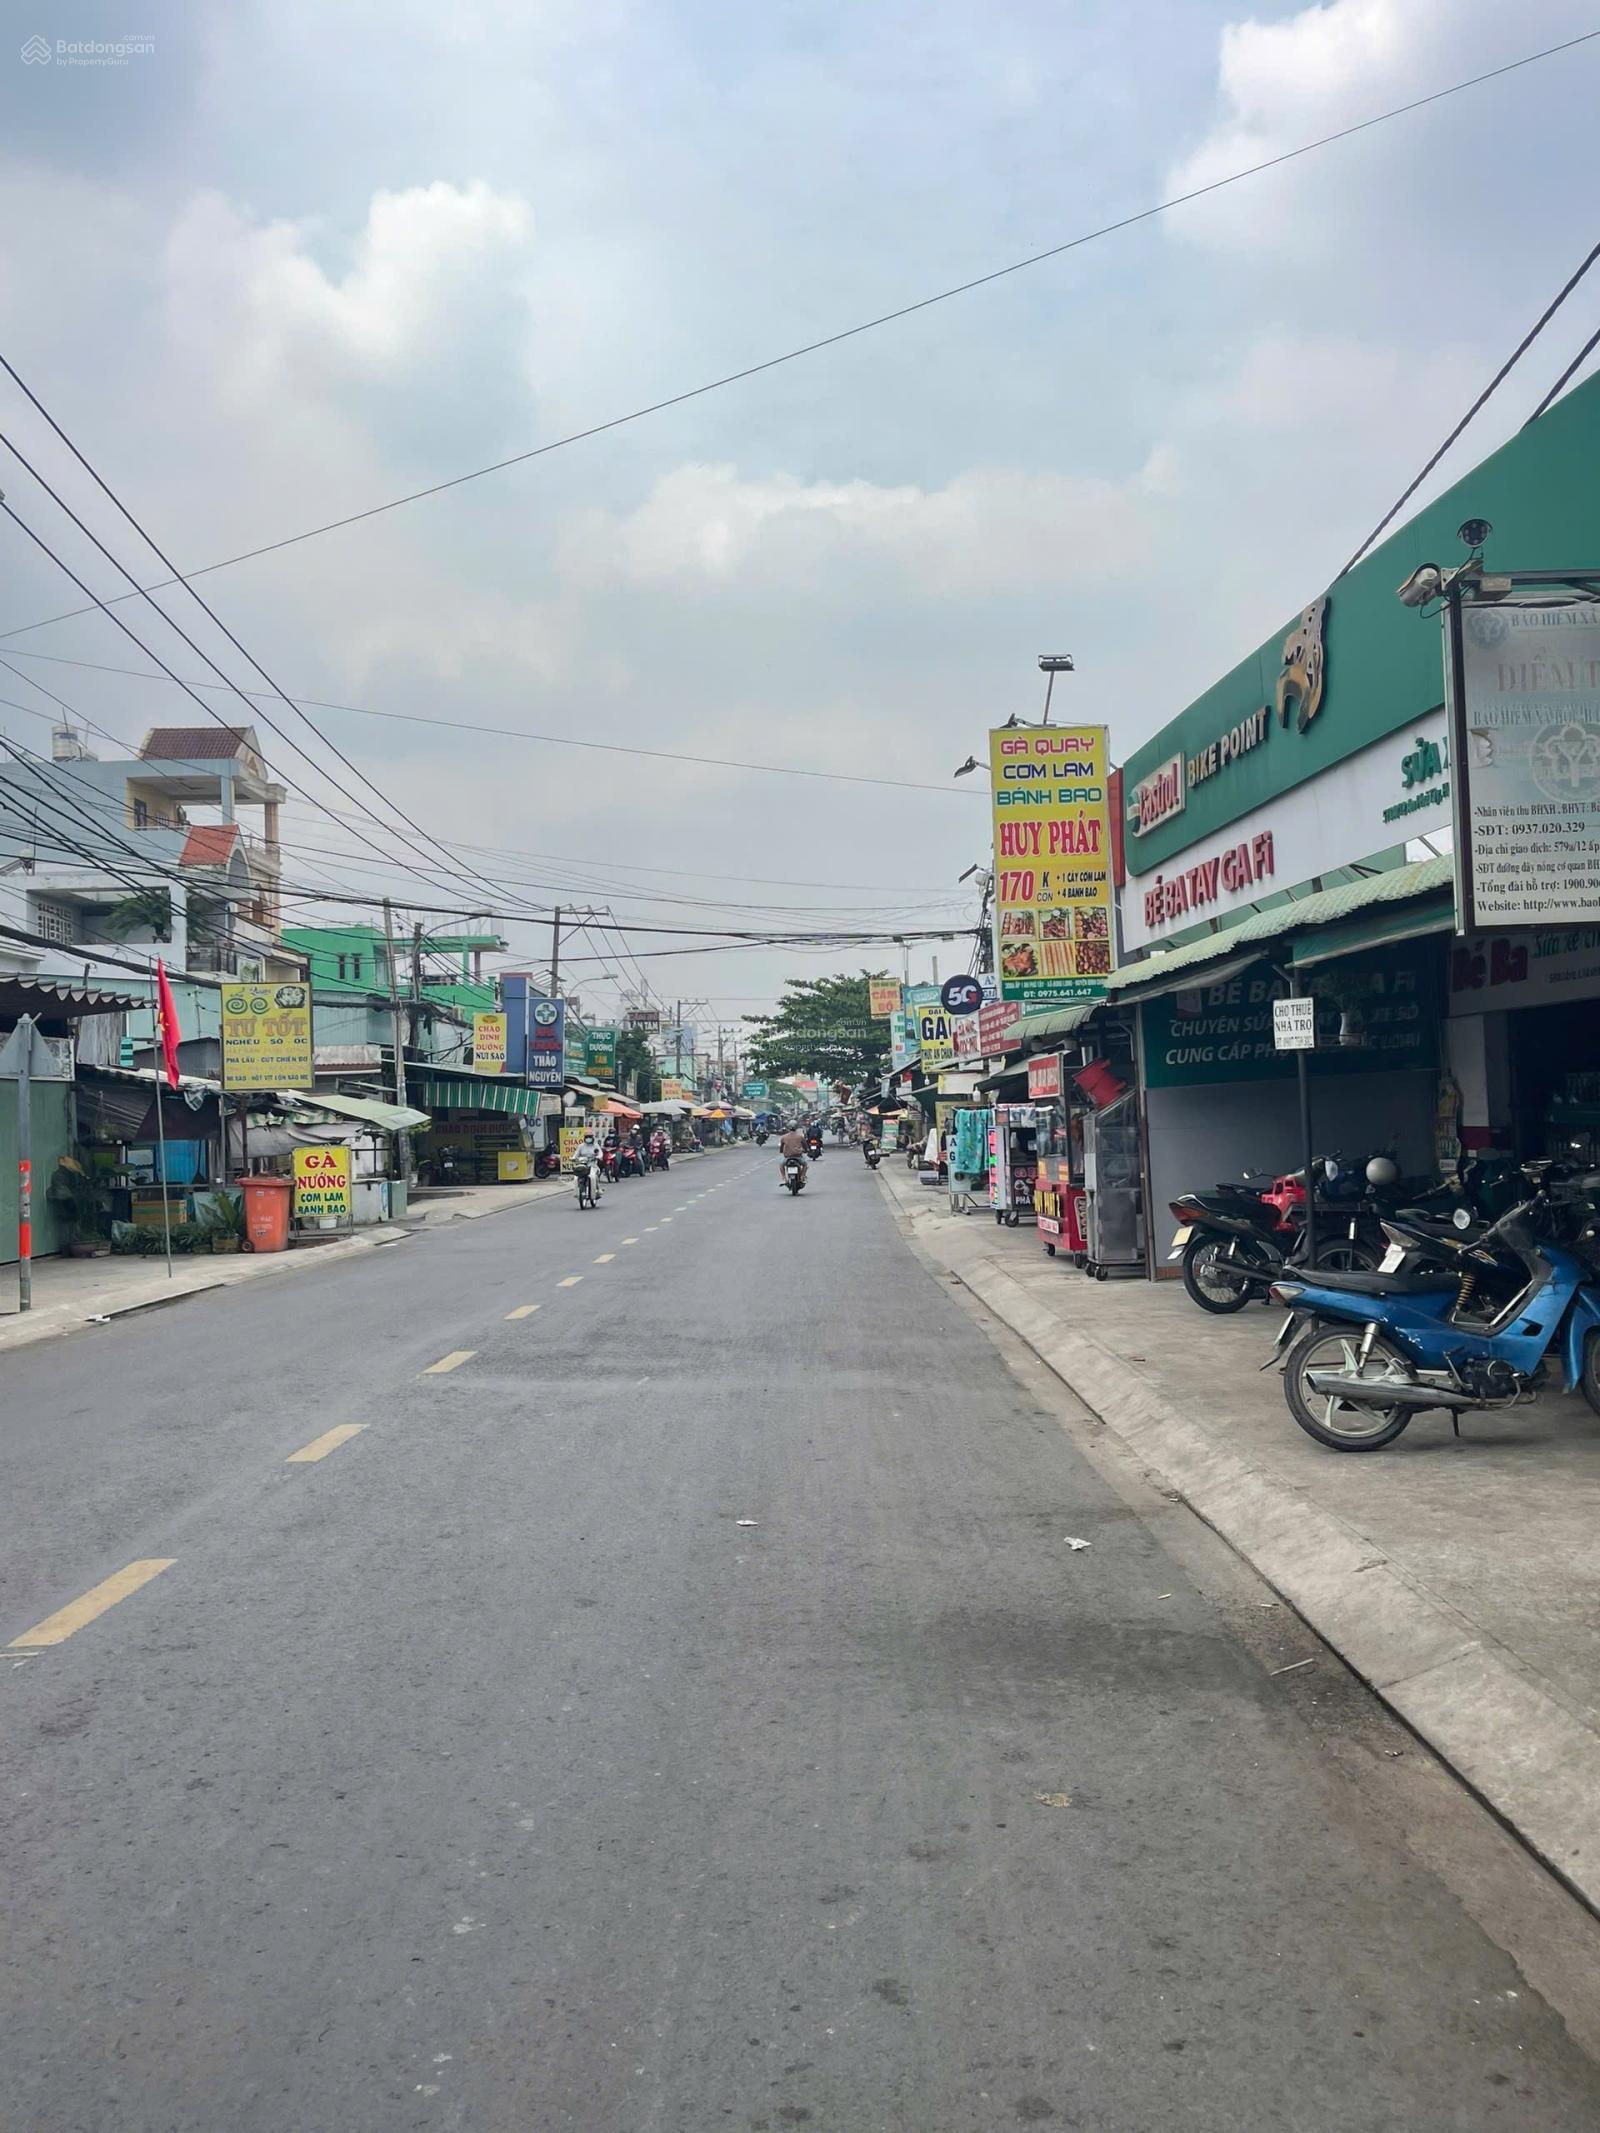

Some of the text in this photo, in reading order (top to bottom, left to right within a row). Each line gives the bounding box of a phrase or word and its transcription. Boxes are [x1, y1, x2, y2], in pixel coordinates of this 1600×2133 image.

[1001, 737, 1094, 756] GÀ QUAY
[1188, 704, 1271, 787] BIKE POINT
[1004, 762, 1094, 779] CƠM LAM
[1402, 737, 1442, 788] SỬA
[997, 786, 1102, 805] BÁNH BAO
[1139, 762, 1180, 827] Castrol
[1499, 806, 1515, 816] viên
[1517, 804, 1530, 816] thu
[999, 810, 1101, 856] HUY PHÁT
[1512, 821, 1585, 836] 0937.020.329
[1511, 844, 1529, 857] giao
[1568, 862, 1585, 873] quan
[1000, 871, 1035, 902] 170
[1042, 872, 1050, 888] K
[1145, 875, 1165, 927] BÉ
[1166, 878, 1188, 918] BA
[1186, 856, 1220, 908] TAY
[1220, 842, 1253, 891] GA
[1508, 881, 1524, 892] đài
[1036, 893, 1054, 902] CON
[1477, 901, 1520, 912] Website:
[1490, 937, 1528, 986] Ba
[948, 984, 977, 1006] 5G
[1038, 988, 1093, 998] 0975.641.647
[1208, 975, 1243, 1006] BÉ
[1275, 1000, 1312, 1017] CHO THUÊ
[1170, 1016, 1239, 1036] CHUYÊN
[1276, 1018, 1292, 1031] NHÀ
[1295, 1019, 1312, 1033] TRỌ
[534, 1051, 556, 1067] THẢO
[1166, 1046, 1214, 1064] CUNG
[1218, 1039, 1252, 1061] CẤP
[305, 1151, 337, 1168] GÀ
[298, 1172, 346, 1189] NƯỚNG
[324, 1193, 343, 1201] LAM
[327, 1205, 346, 1213] BAO
